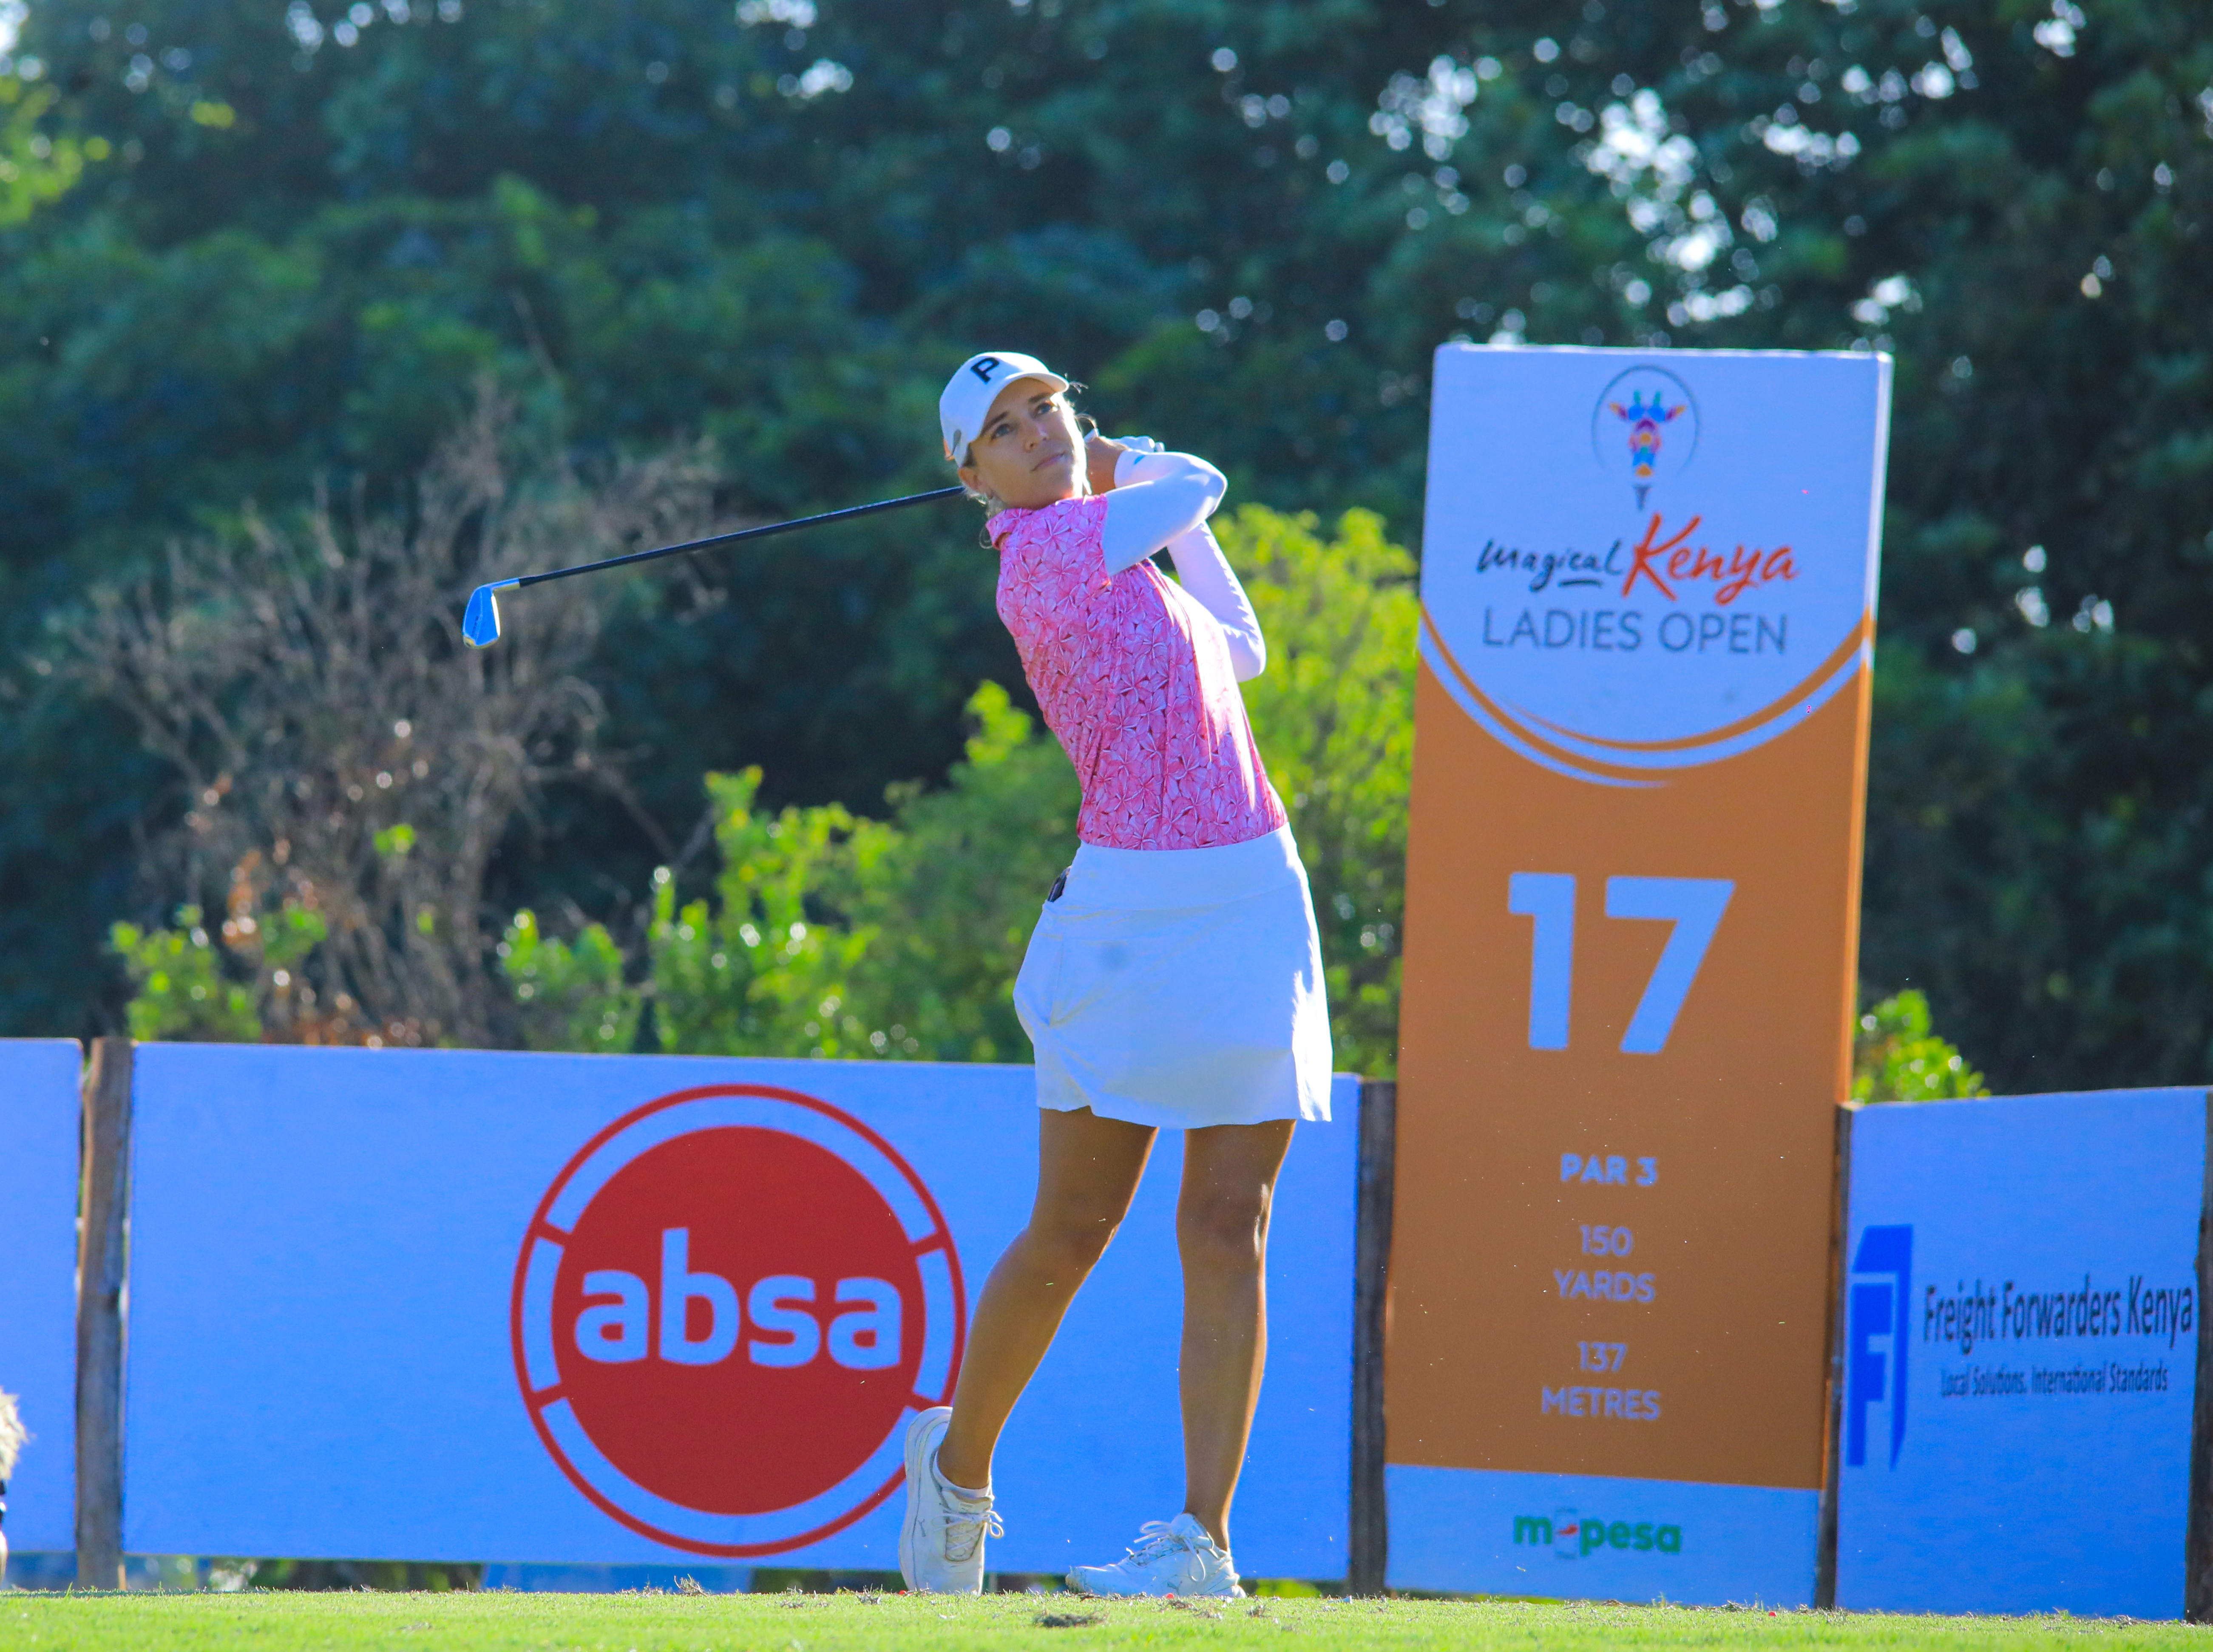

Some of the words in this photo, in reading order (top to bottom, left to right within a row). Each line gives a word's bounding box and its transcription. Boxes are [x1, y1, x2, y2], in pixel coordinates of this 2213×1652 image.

[970, 357, 1000, 383] P
[1622, 511, 1801, 606] Kenya
[1482, 608, 1643, 651] LADIES
[1657, 611, 1788, 655] OPEN
[1508, 872, 1736, 1054] 17
[1560, 1153, 1628, 1185] PAR
[1635, 1156, 1658, 1186] 3
[1579, 1225, 1634, 1257] 150
[574, 1227, 902, 1371] absa
[1553, 1269, 1657, 1303] YARDS
[1923, 1278, 1997, 1356] Freight
[2001, 1273, 2122, 1340] Forwarders
[2126, 1275, 2193, 1349] Kenya
[1578, 1341, 1628, 1372] 137
[1940, 1363, 1972, 1398] Local
[2031, 1361, 2107, 1394] International
[2108, 1360, 2169, 1393] Standards
[1541, 1386, 1661, 1420] METRES
